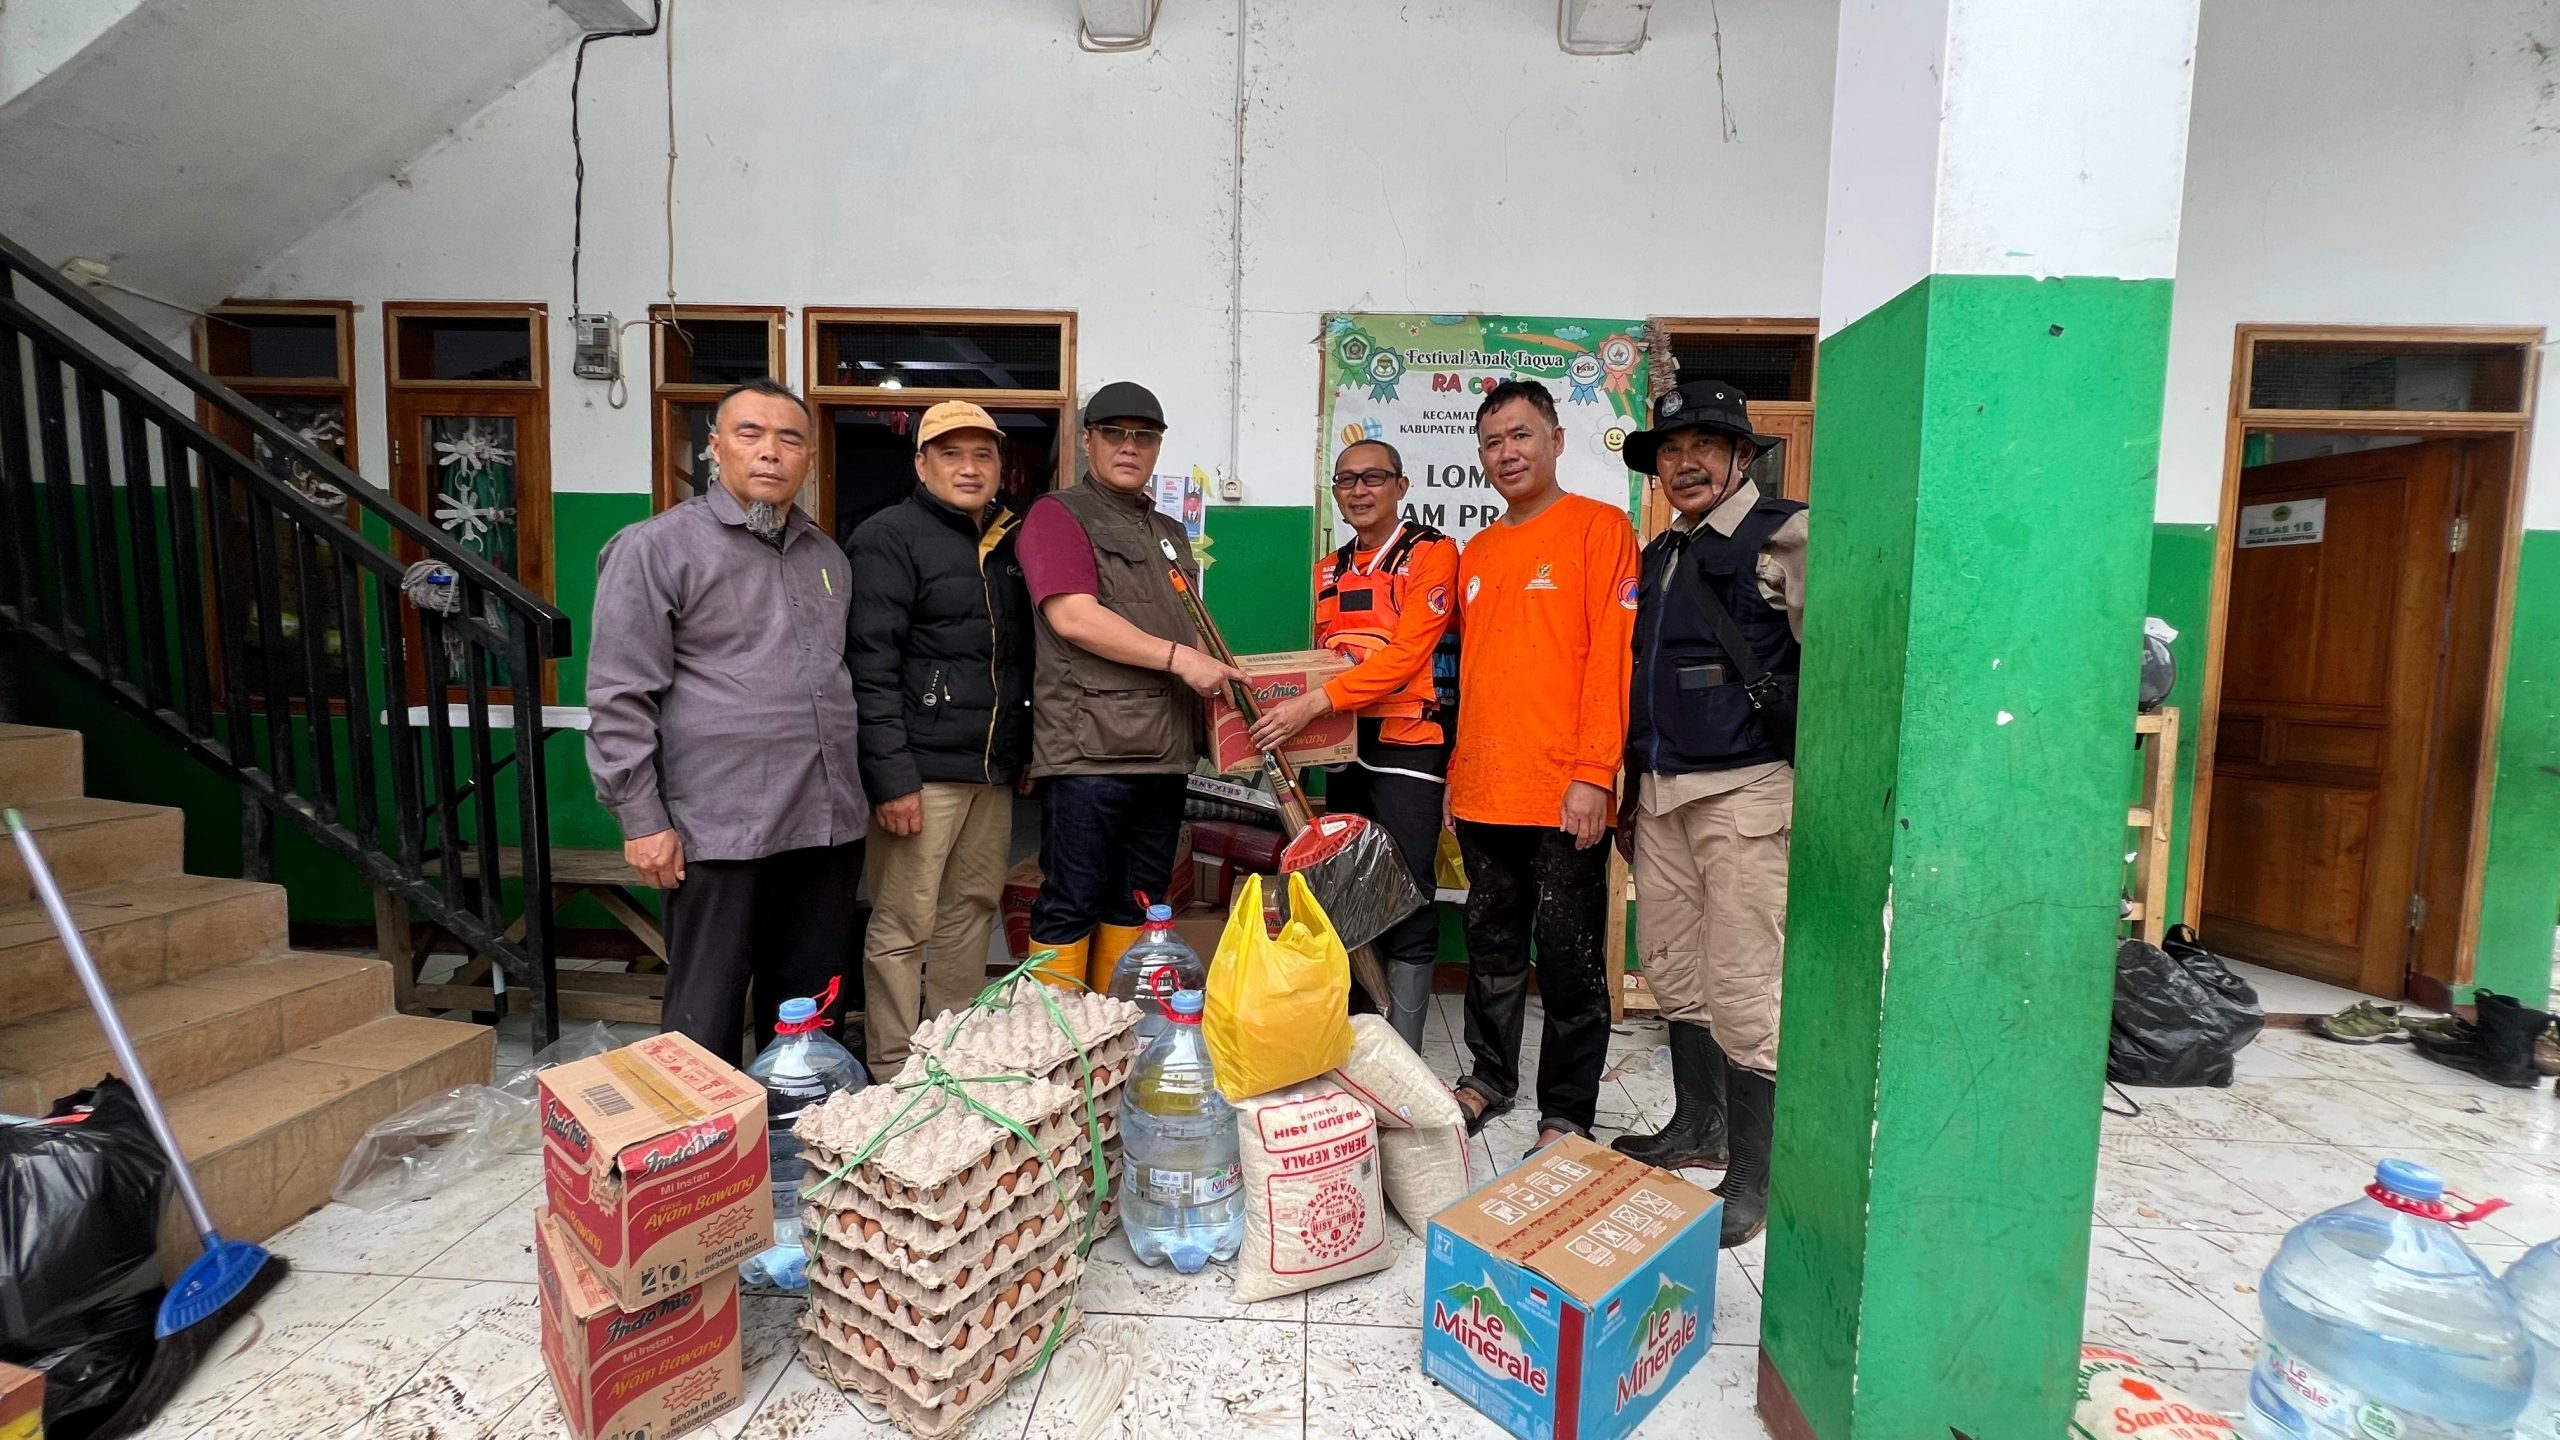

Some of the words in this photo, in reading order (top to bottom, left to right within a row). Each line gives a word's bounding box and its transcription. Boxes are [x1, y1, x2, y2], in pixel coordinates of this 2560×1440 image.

[1406, 350, 1464, 365] Festival
[1466, 350, 1513, 369] Anak
[1514, 351, 1564, 370] Taqwa
[1432, 373, 1462, 393] RA
[1423, 411, 1476, 420] KECAMAT
[1400, 425, 1464, 434] KABUPATEN
[1469, 426, 1477, 434] B
[1427, 465, 1490, 488] LOM
[1401, 503, 1445, 528] AM
[1460, 504, 1500, 528] PR
[2248, 525, 2290, 536] KELAS
[1274, 1124, 1308, 1139] ASIH
[1334, 1134, 1367, 1158] BERAS
[1282, 1148, 1330, 1169] KEPALA
[677, 1171, 710, 1189] Instan
[644, 1203, 692, 1231] Ayam
[695, 1174, 755, 1211] Bawang
[704, 1244, 732, 1263] BPOM
[734, 1240, 742, 1252] RI
[745, 1232, 758, 1245] MD
[1473, 1297, 1504, 1341] Le
[1648, 1309, 1671, 1351] Le
[639, 1335, 674, 1356] Instan
[1434, 1301, 1546, 1395] Minerale
[608, 1367, 657, 1400] Ayam
[658, 1336, 723, 1375] Bawang
[1615, 1313, 1697, 1413] Minerale
[2290, 1360, 2307, 1382] Le
[671, 1407, 699, 1426] BPOM
[713, 1392, 727, 1404] MD
